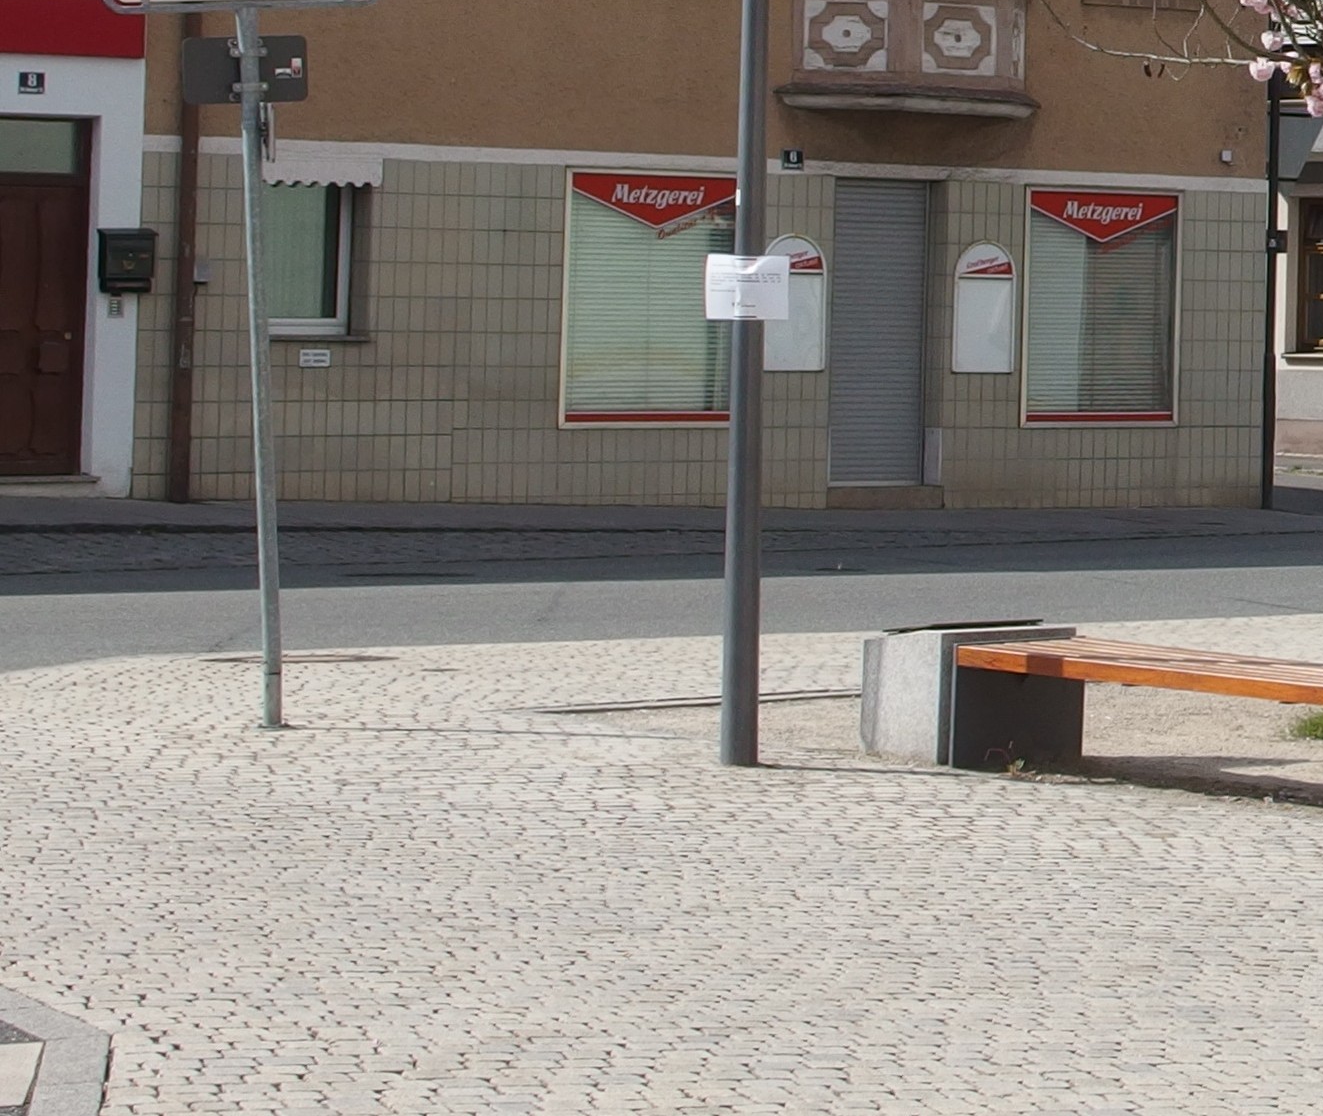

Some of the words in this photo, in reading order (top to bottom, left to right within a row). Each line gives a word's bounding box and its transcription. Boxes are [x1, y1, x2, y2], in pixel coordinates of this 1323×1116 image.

[27, 73, 37, 87] 8
[611, 183, 705, 209] Metzgerei
[1062, 200, 1143, 225] Metzgerei
